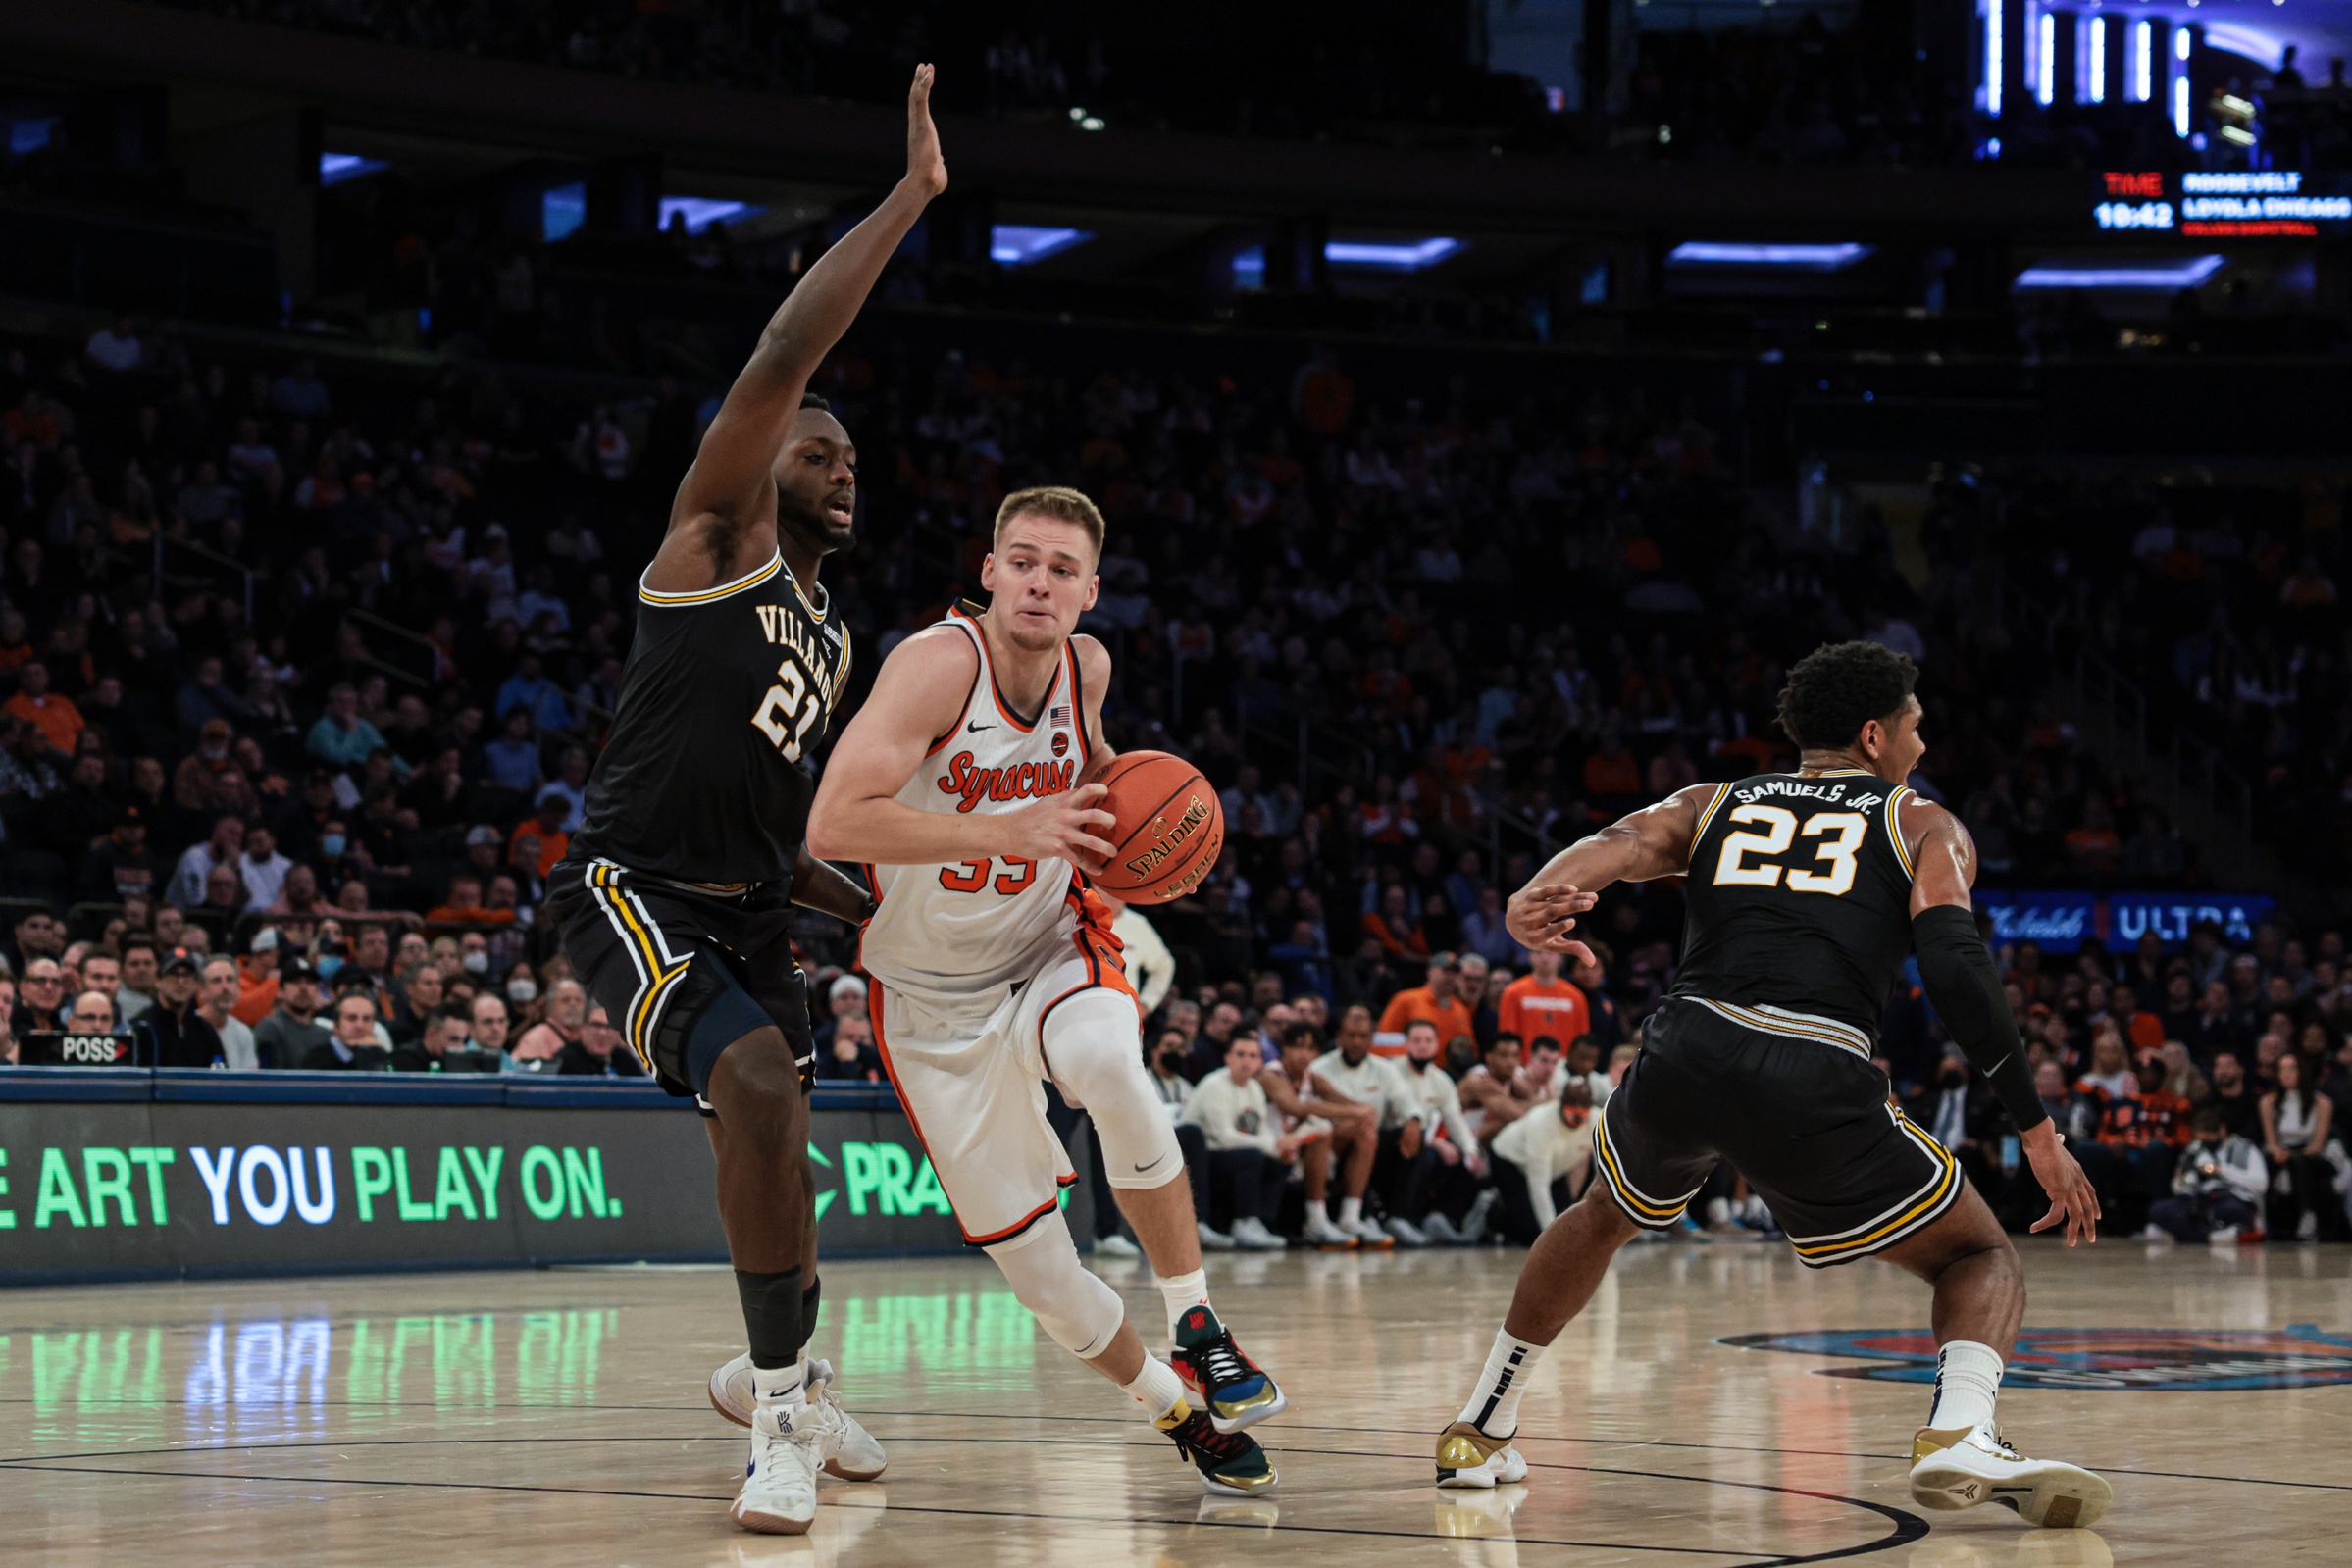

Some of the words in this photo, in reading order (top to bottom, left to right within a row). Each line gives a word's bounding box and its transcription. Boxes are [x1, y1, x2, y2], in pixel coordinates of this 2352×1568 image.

[2103, 172, 2163, 196] TIME
[2181, 197, 2262, 219] LOYOLA
[755, 604, 834, 736] VILLANOV
[750, 659, 820, 764] 21
[938, 751, 1075, 813] Syracuse
[1733, 781, 1847, 804] SAMUELS
[1845, 791, 1883, 816] JR.
[1125, 795, 1209, 882] SPALDING
[1153, 833, 1220, 898] LEGACY
[1712, 803, 1869, 896] 23
[63, 1037, 117, 1063] POSS
[34, 1146, 176, 1229] ART
[188, 1143, 337, 1226] YOU
[350, 1145, 504, 1223] PLAY
[520, 1144, 624, 1222] ON.
